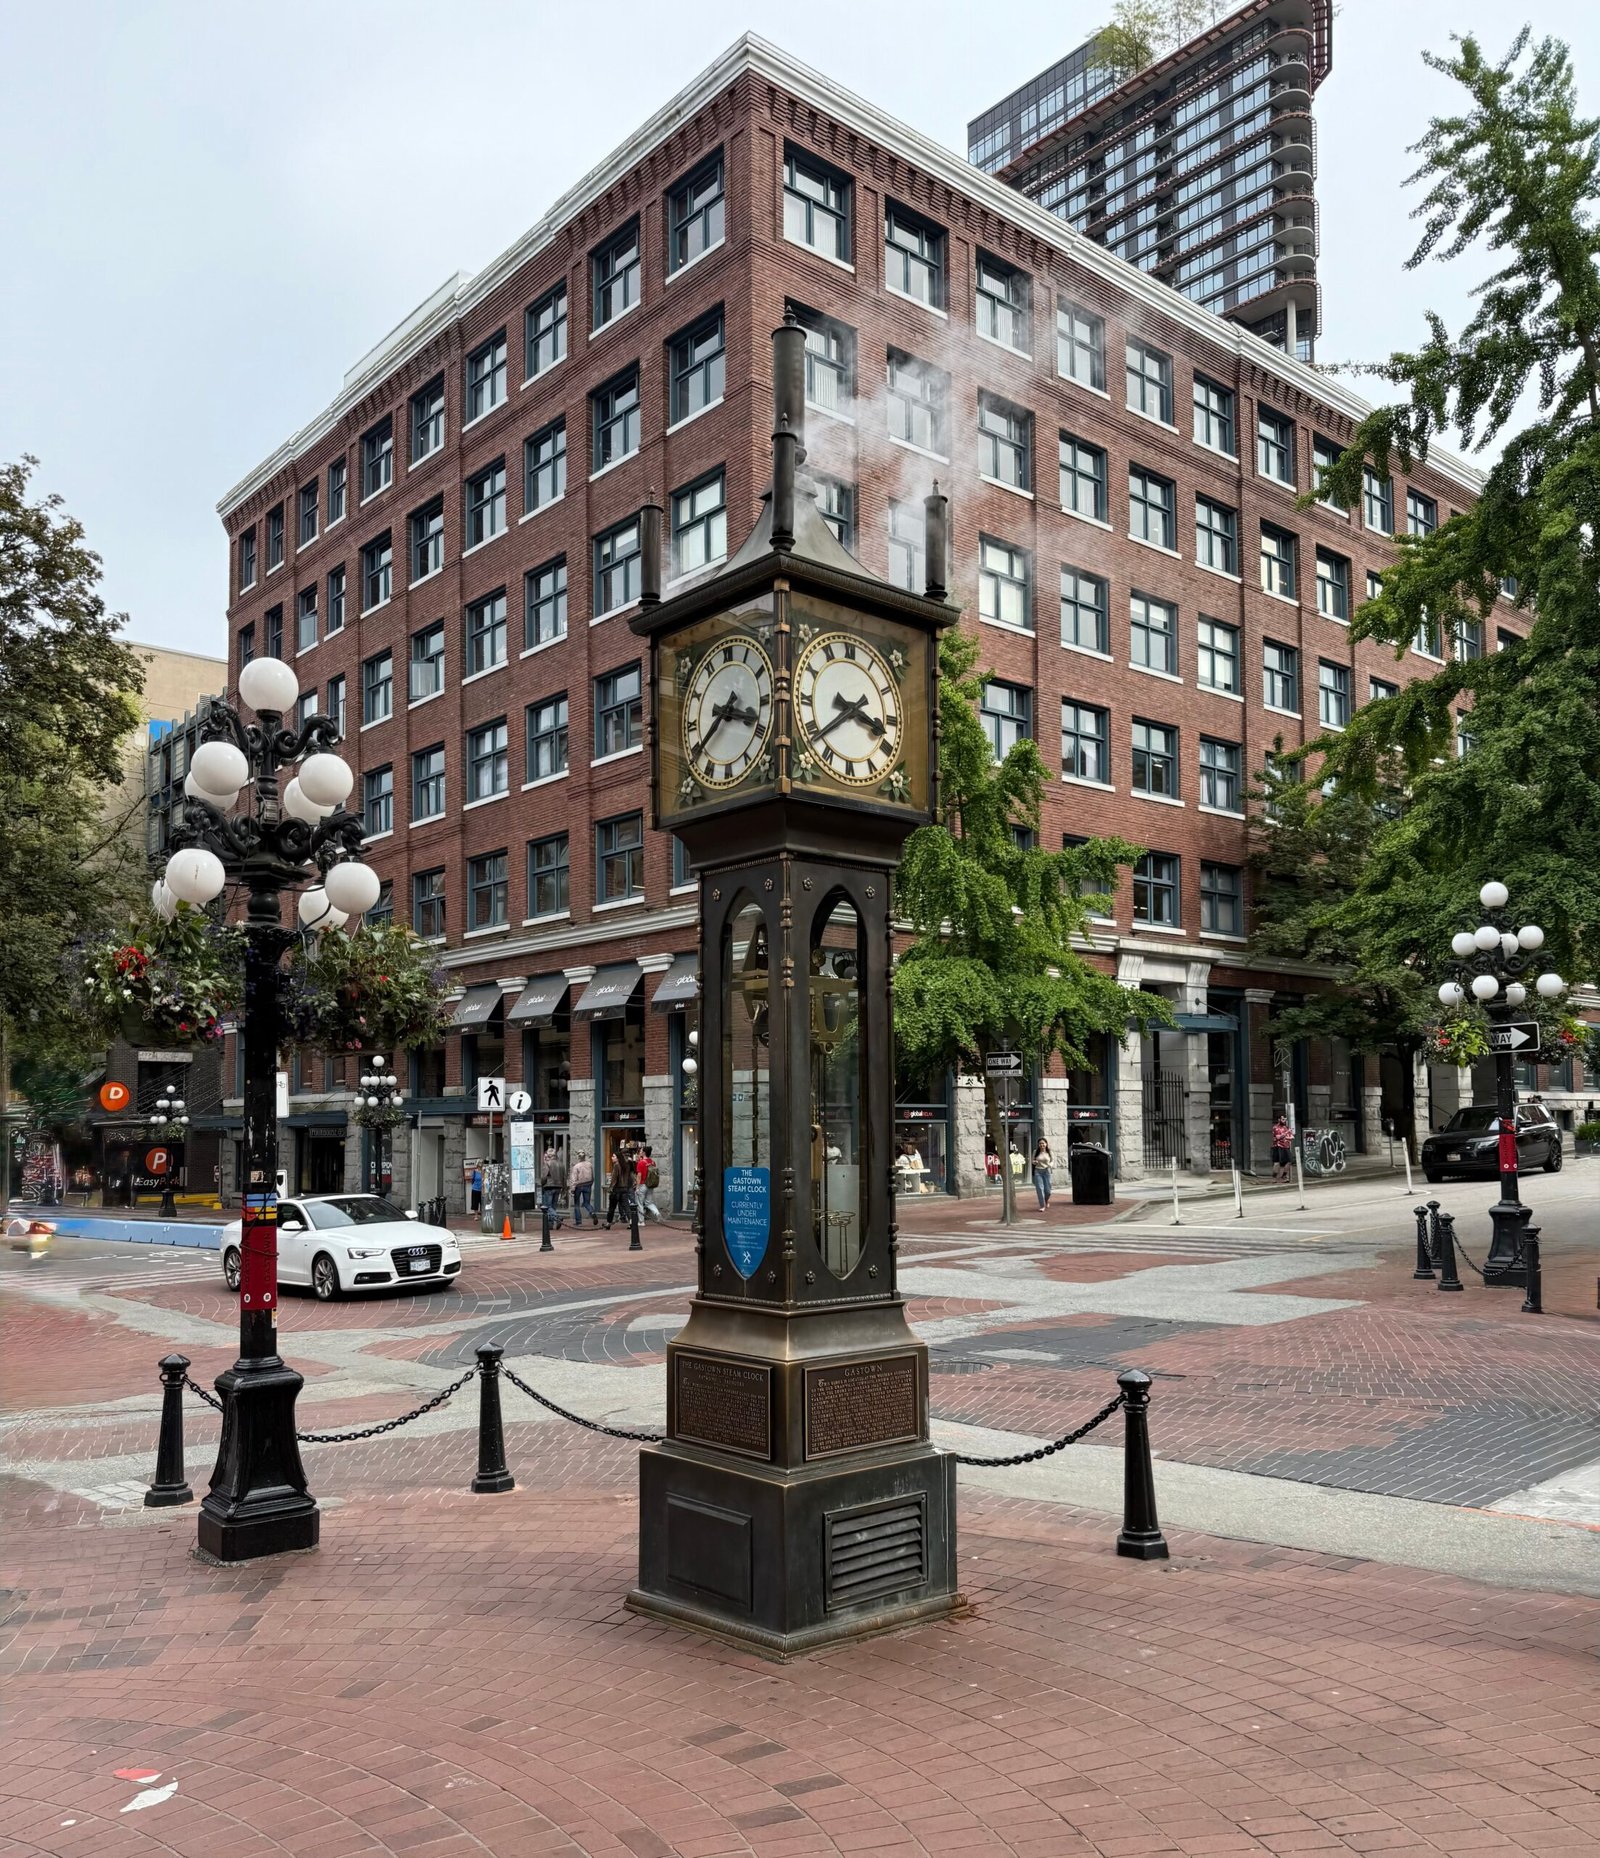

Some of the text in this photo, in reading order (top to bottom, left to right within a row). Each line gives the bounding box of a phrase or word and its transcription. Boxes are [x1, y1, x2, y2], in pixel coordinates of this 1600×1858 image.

[1492, 1032, 1511, 1044] WAY
[153, 1152, 166, 1170] P
[139, 1177, 180, 1188] EasyPrk
[733, 1177, 761, 1185] GASTOWN
[747, 1185, 767, 1193] CLOCK
[731, 1201, 763, 1209] CURRENTLY
[727, 1217, 767, 1226] MAINTENANCE
[682, 1361, 764, 1382] THE GASTOWN STEAM CLOCK
[844, 1364, 883, 1377] GASTOWN
